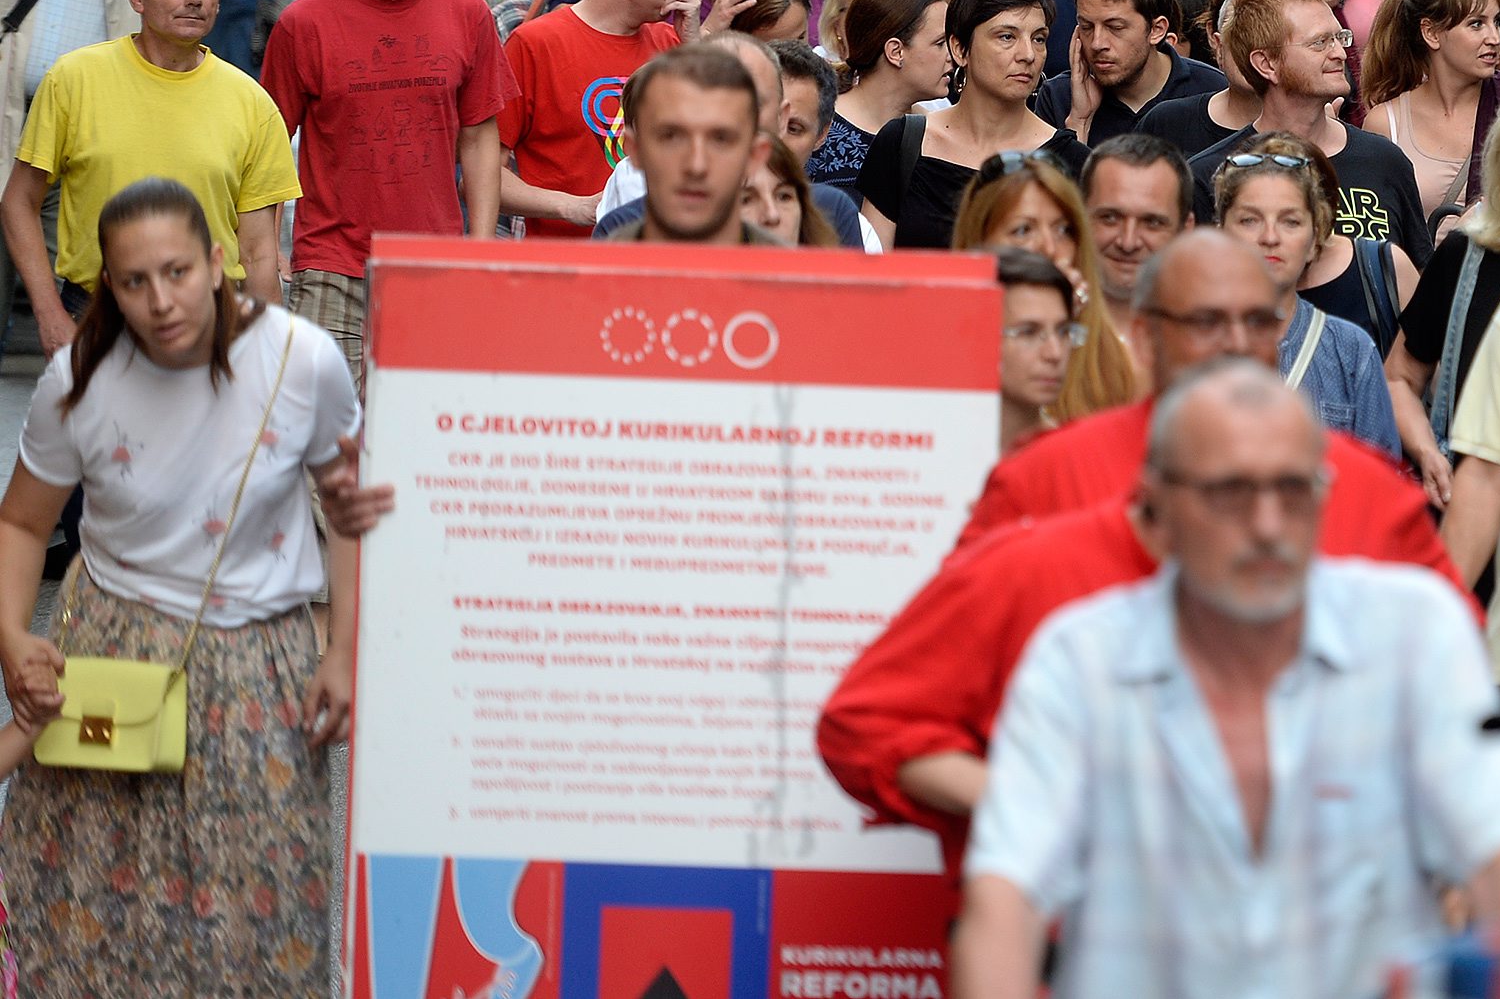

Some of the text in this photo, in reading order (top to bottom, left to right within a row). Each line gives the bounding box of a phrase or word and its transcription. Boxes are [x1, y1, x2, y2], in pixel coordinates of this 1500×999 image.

[437, 414, 934, 449] O CJELOVITOJ KURIKULARNOJ REFORMI
[780, 945, 943, 969] KURIKULARNA
[780, 969, 943, 999] REFORMA
